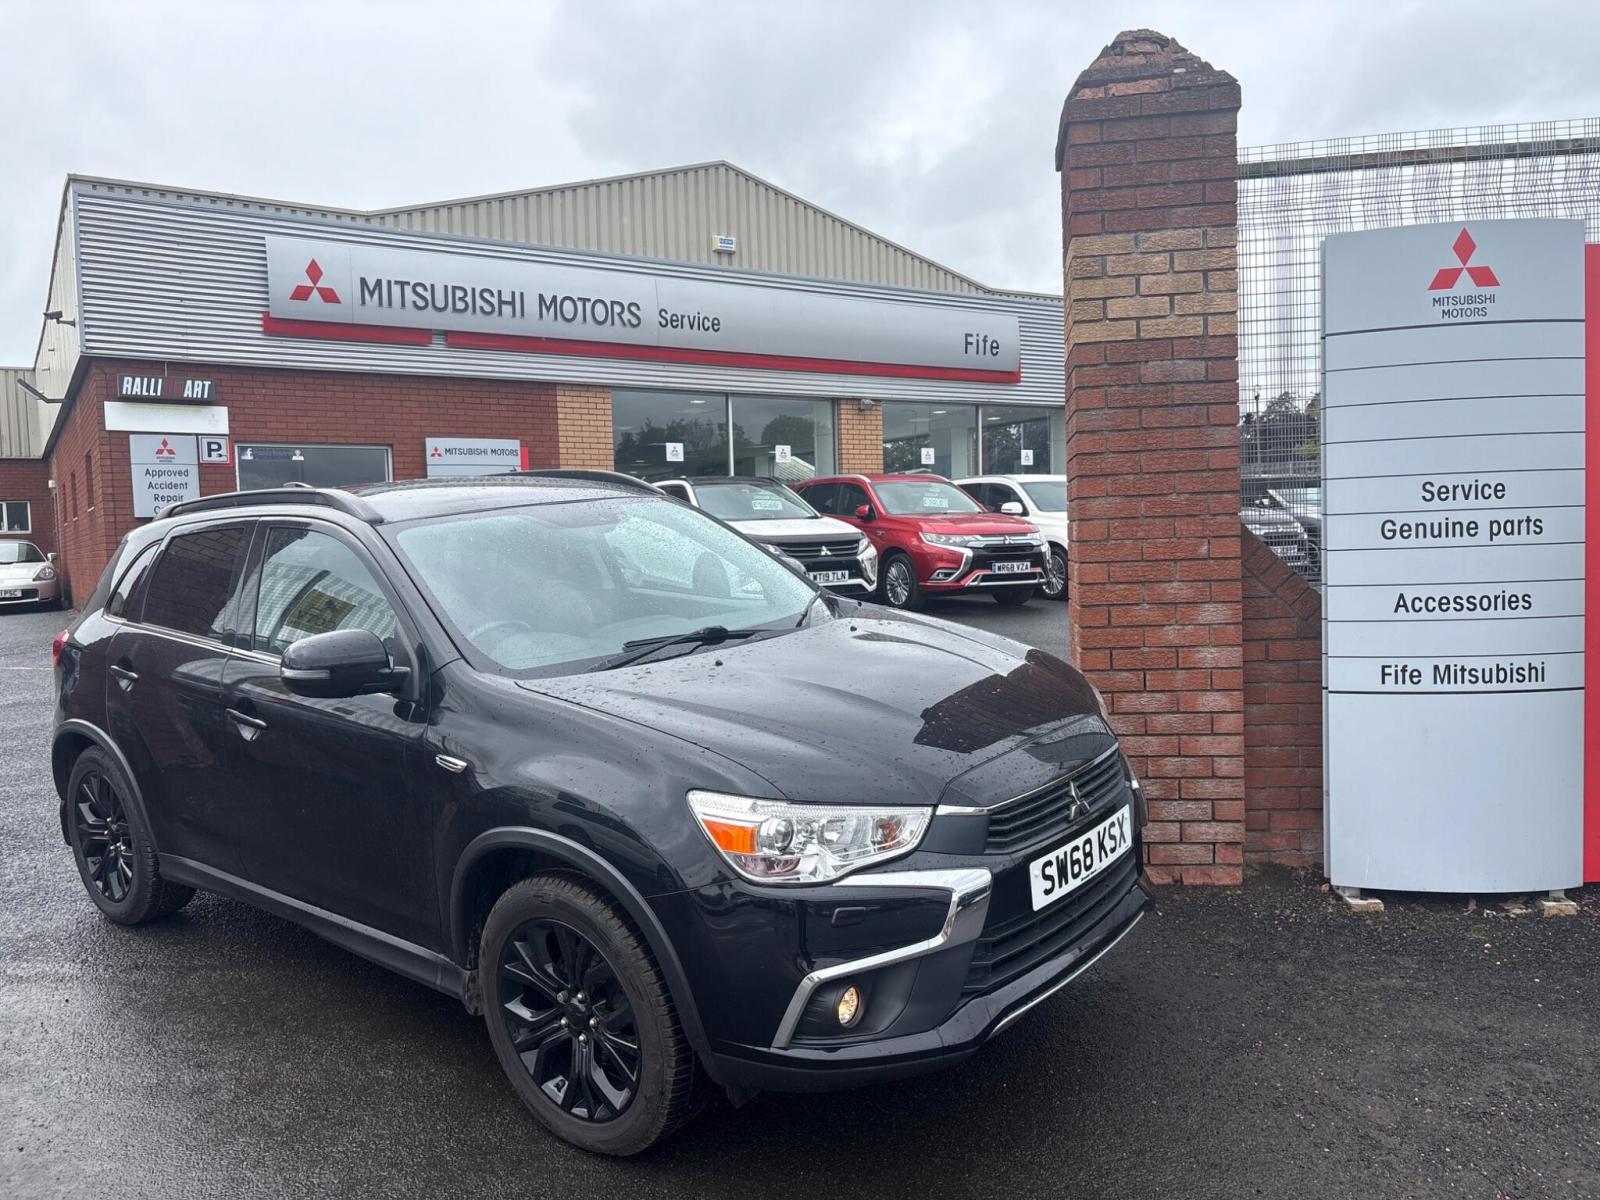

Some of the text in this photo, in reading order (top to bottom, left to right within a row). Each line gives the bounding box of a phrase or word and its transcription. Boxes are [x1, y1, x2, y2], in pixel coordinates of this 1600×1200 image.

[359, 276, 642, 329] MITSUBISHI MOTORS
[1432, 294, 1496, 307] MITSUBISHI
[658, 308, 721, 333] Service
[1441, 306, 1488, 319] MOTORS
[964, 332, 1000, 357] Fife
[122, 376, 212, 399] RALLI ART
[206, 441, 222, 458] P
[444, 447, 519, 457] MITSUBISHI MOTORS
[144, 467, 189, 478] Approved
[147, 481, 188, 490] Accident
[1421, 479, 1506, 502] Service
[153, 493, 184, 504] Repair
[1380, 515, 1544, 542] Genuine parts
[1393, 590, 1532, 613] Accessories
[1380, 661, 1545, 685] Fife Mitsubishi
[1041, 813, 1127, 896] SW68 KSX
